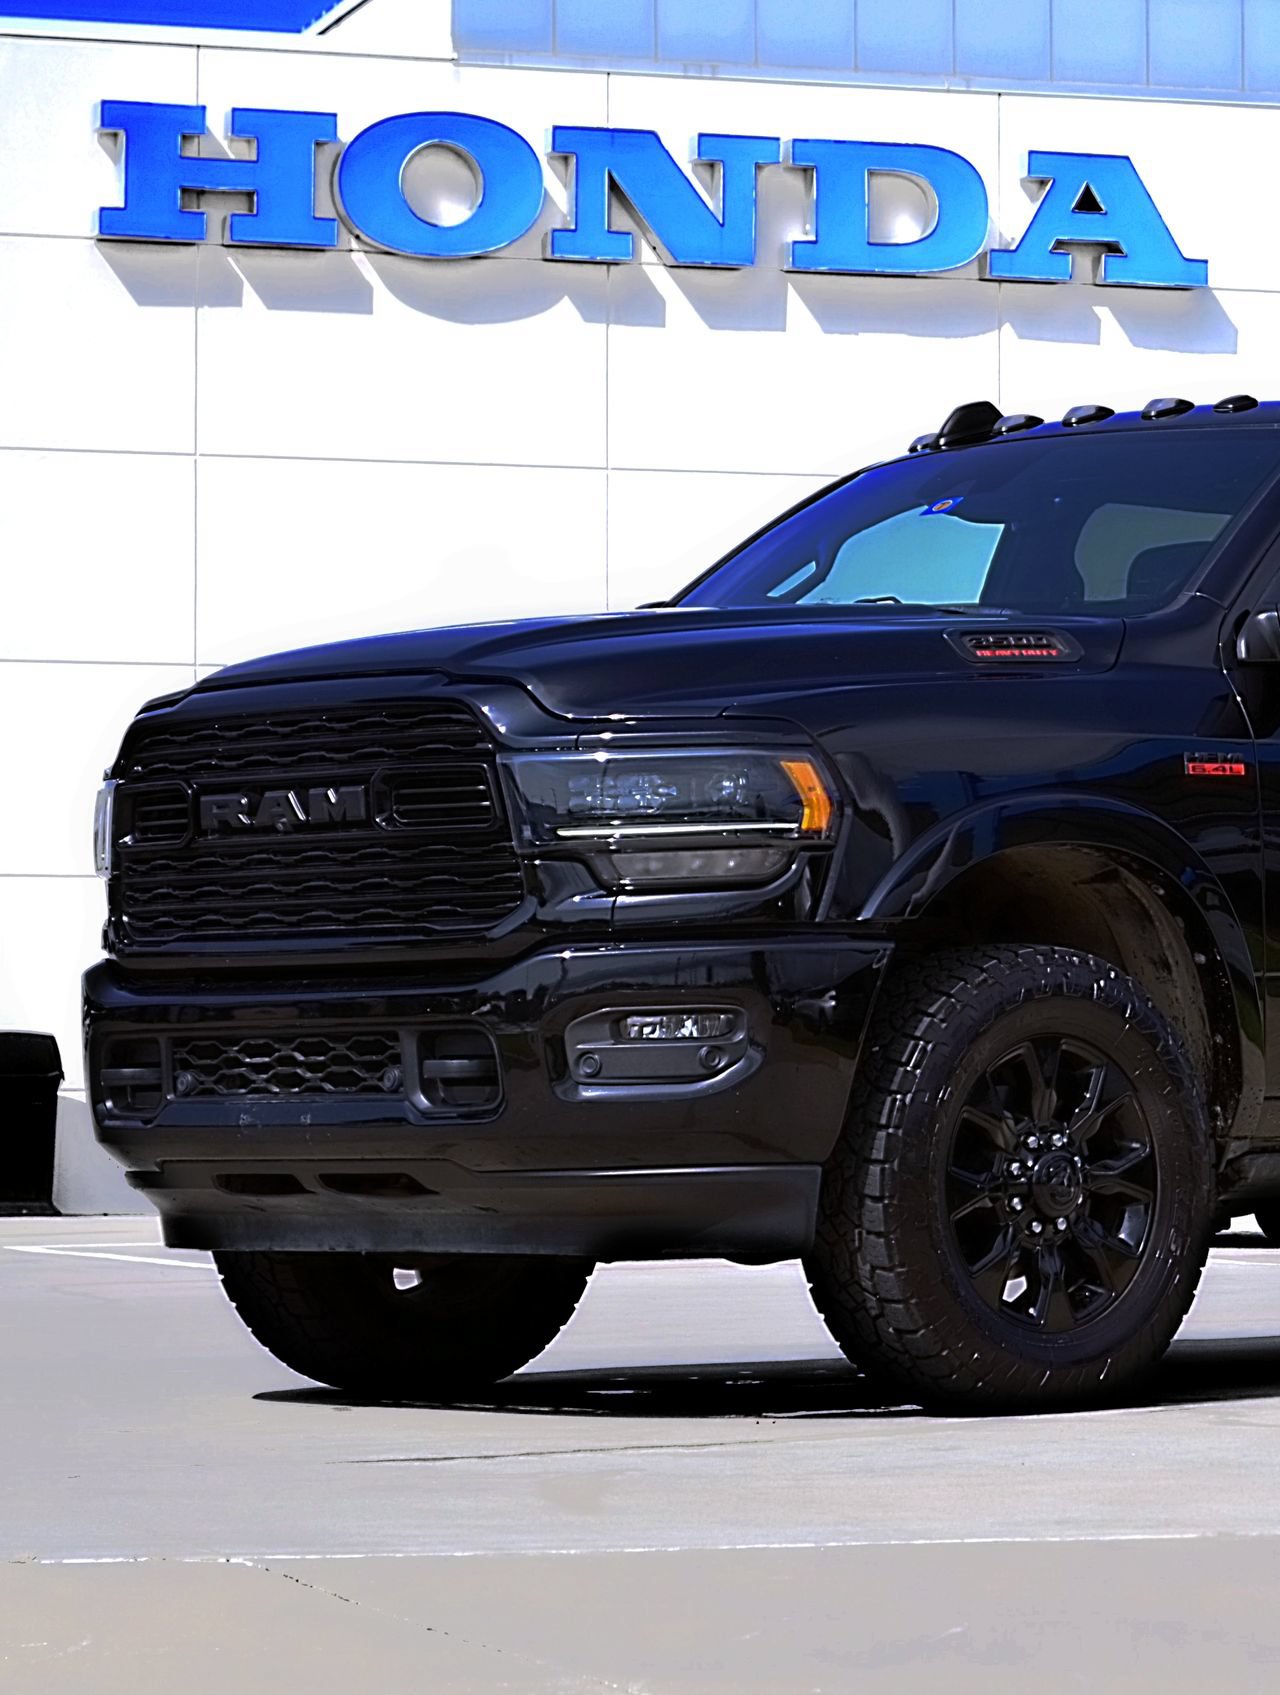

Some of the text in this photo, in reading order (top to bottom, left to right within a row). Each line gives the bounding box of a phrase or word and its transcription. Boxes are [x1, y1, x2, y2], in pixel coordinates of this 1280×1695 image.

[96, 100, 1208, 288] HONDA
[1189, 764, 1243, 775] 6.4L
[199, 785, 368, 830] RAM
